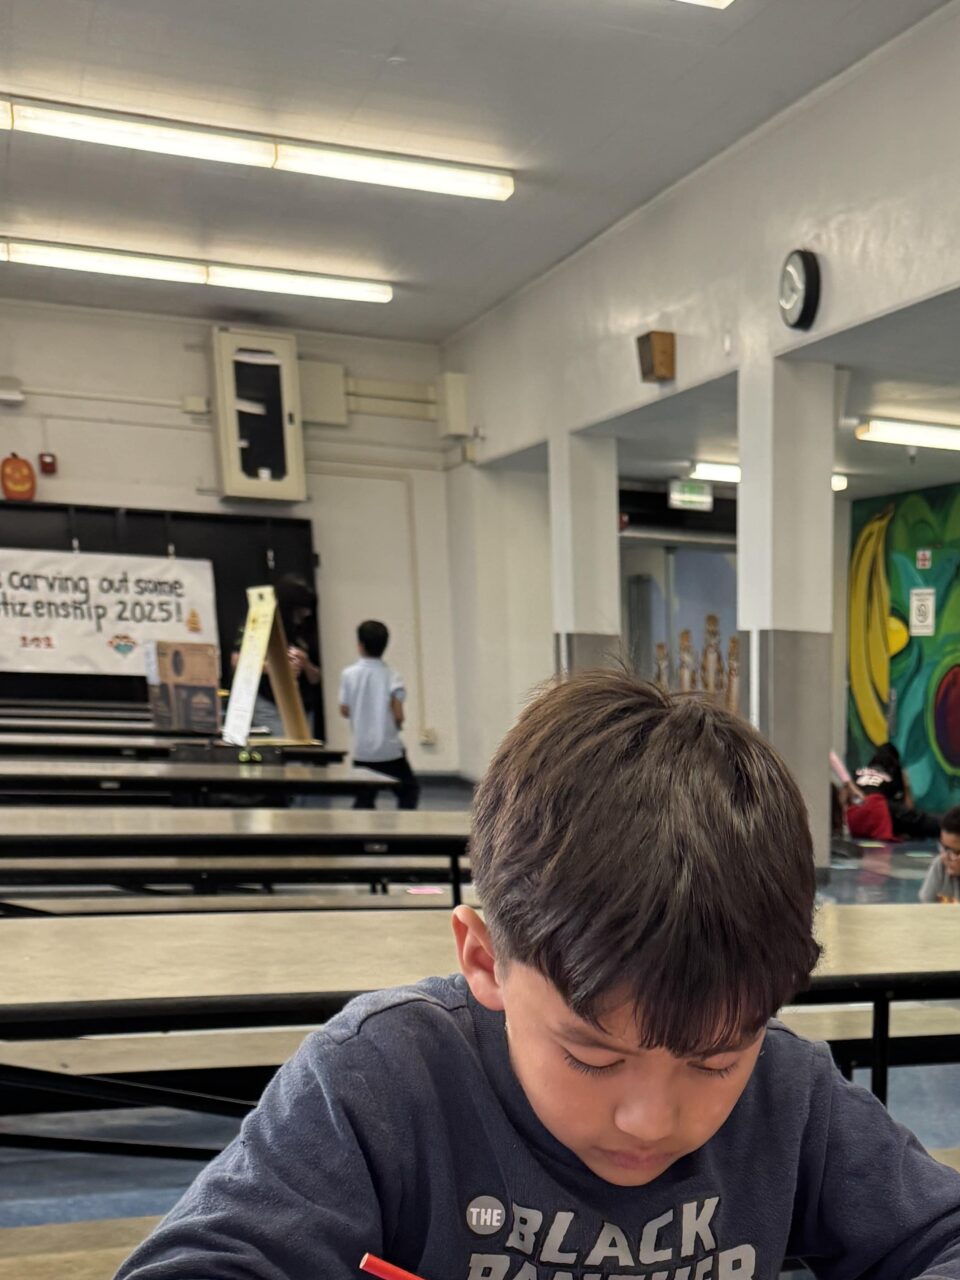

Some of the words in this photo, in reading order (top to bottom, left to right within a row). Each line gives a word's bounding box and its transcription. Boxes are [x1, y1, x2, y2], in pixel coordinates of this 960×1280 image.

[8, 571, 89, 602] carving
[100, 570, 130, 593] out
[135, 579, 185, 597] some
[116, 600, 183, 623] 2025!
[470, 1207, 501, 1226] THE
[504, 1196, 720, 1266] BLACK
